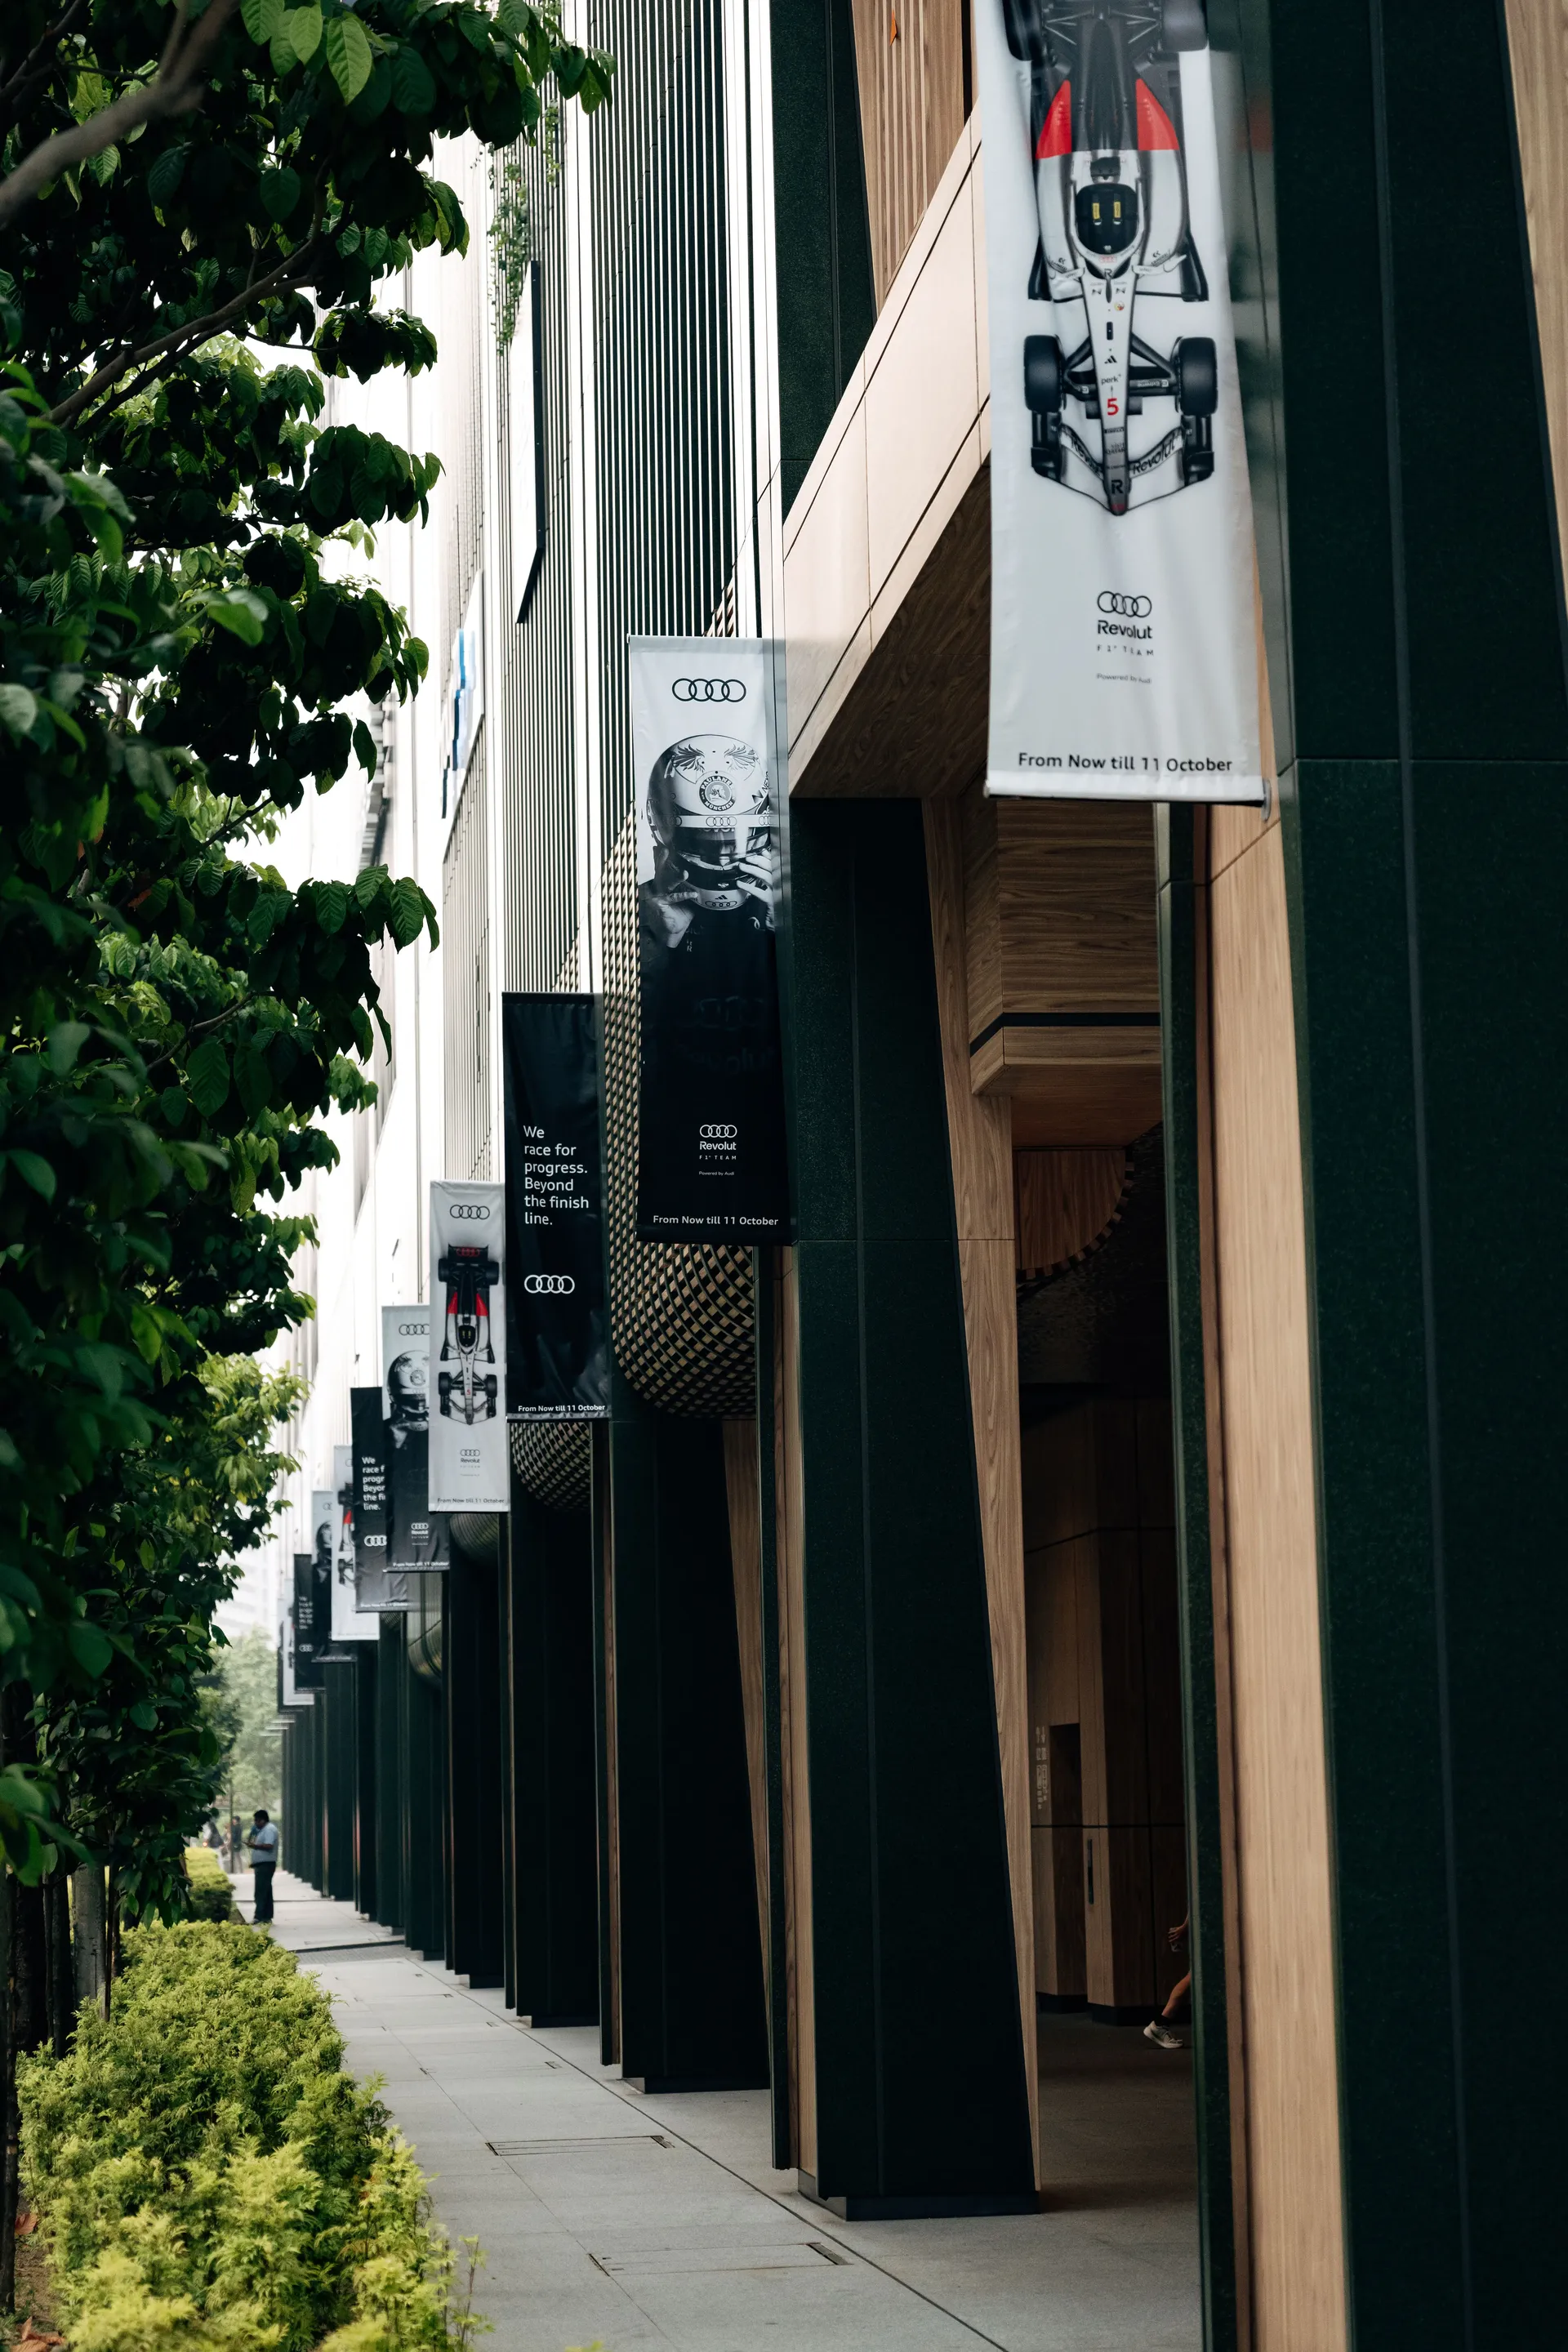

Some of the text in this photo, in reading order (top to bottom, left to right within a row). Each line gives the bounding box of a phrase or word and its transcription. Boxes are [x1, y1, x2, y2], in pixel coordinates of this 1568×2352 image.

[1107, 398, 1119, 416] 5
[1097, 620, 1153, 639] Revolut
[1018, 752, 1233, 772] From Now till 11 October
[523, 1125, 545, 1138] We
[524, 1143, 577, 1156] race for
[699, 1141, 737, 1151] Revolut
[524, 1162, 588, 1177] progress.
[524, 1177, 574, 1194] Beyond
[523, 1194, 590, 1209] the finish
[524, 1211, 553, 1226] line.
[653, 1215, 779, 1226] From Now till 11 October
[362, 1456, 376, 1464] We
